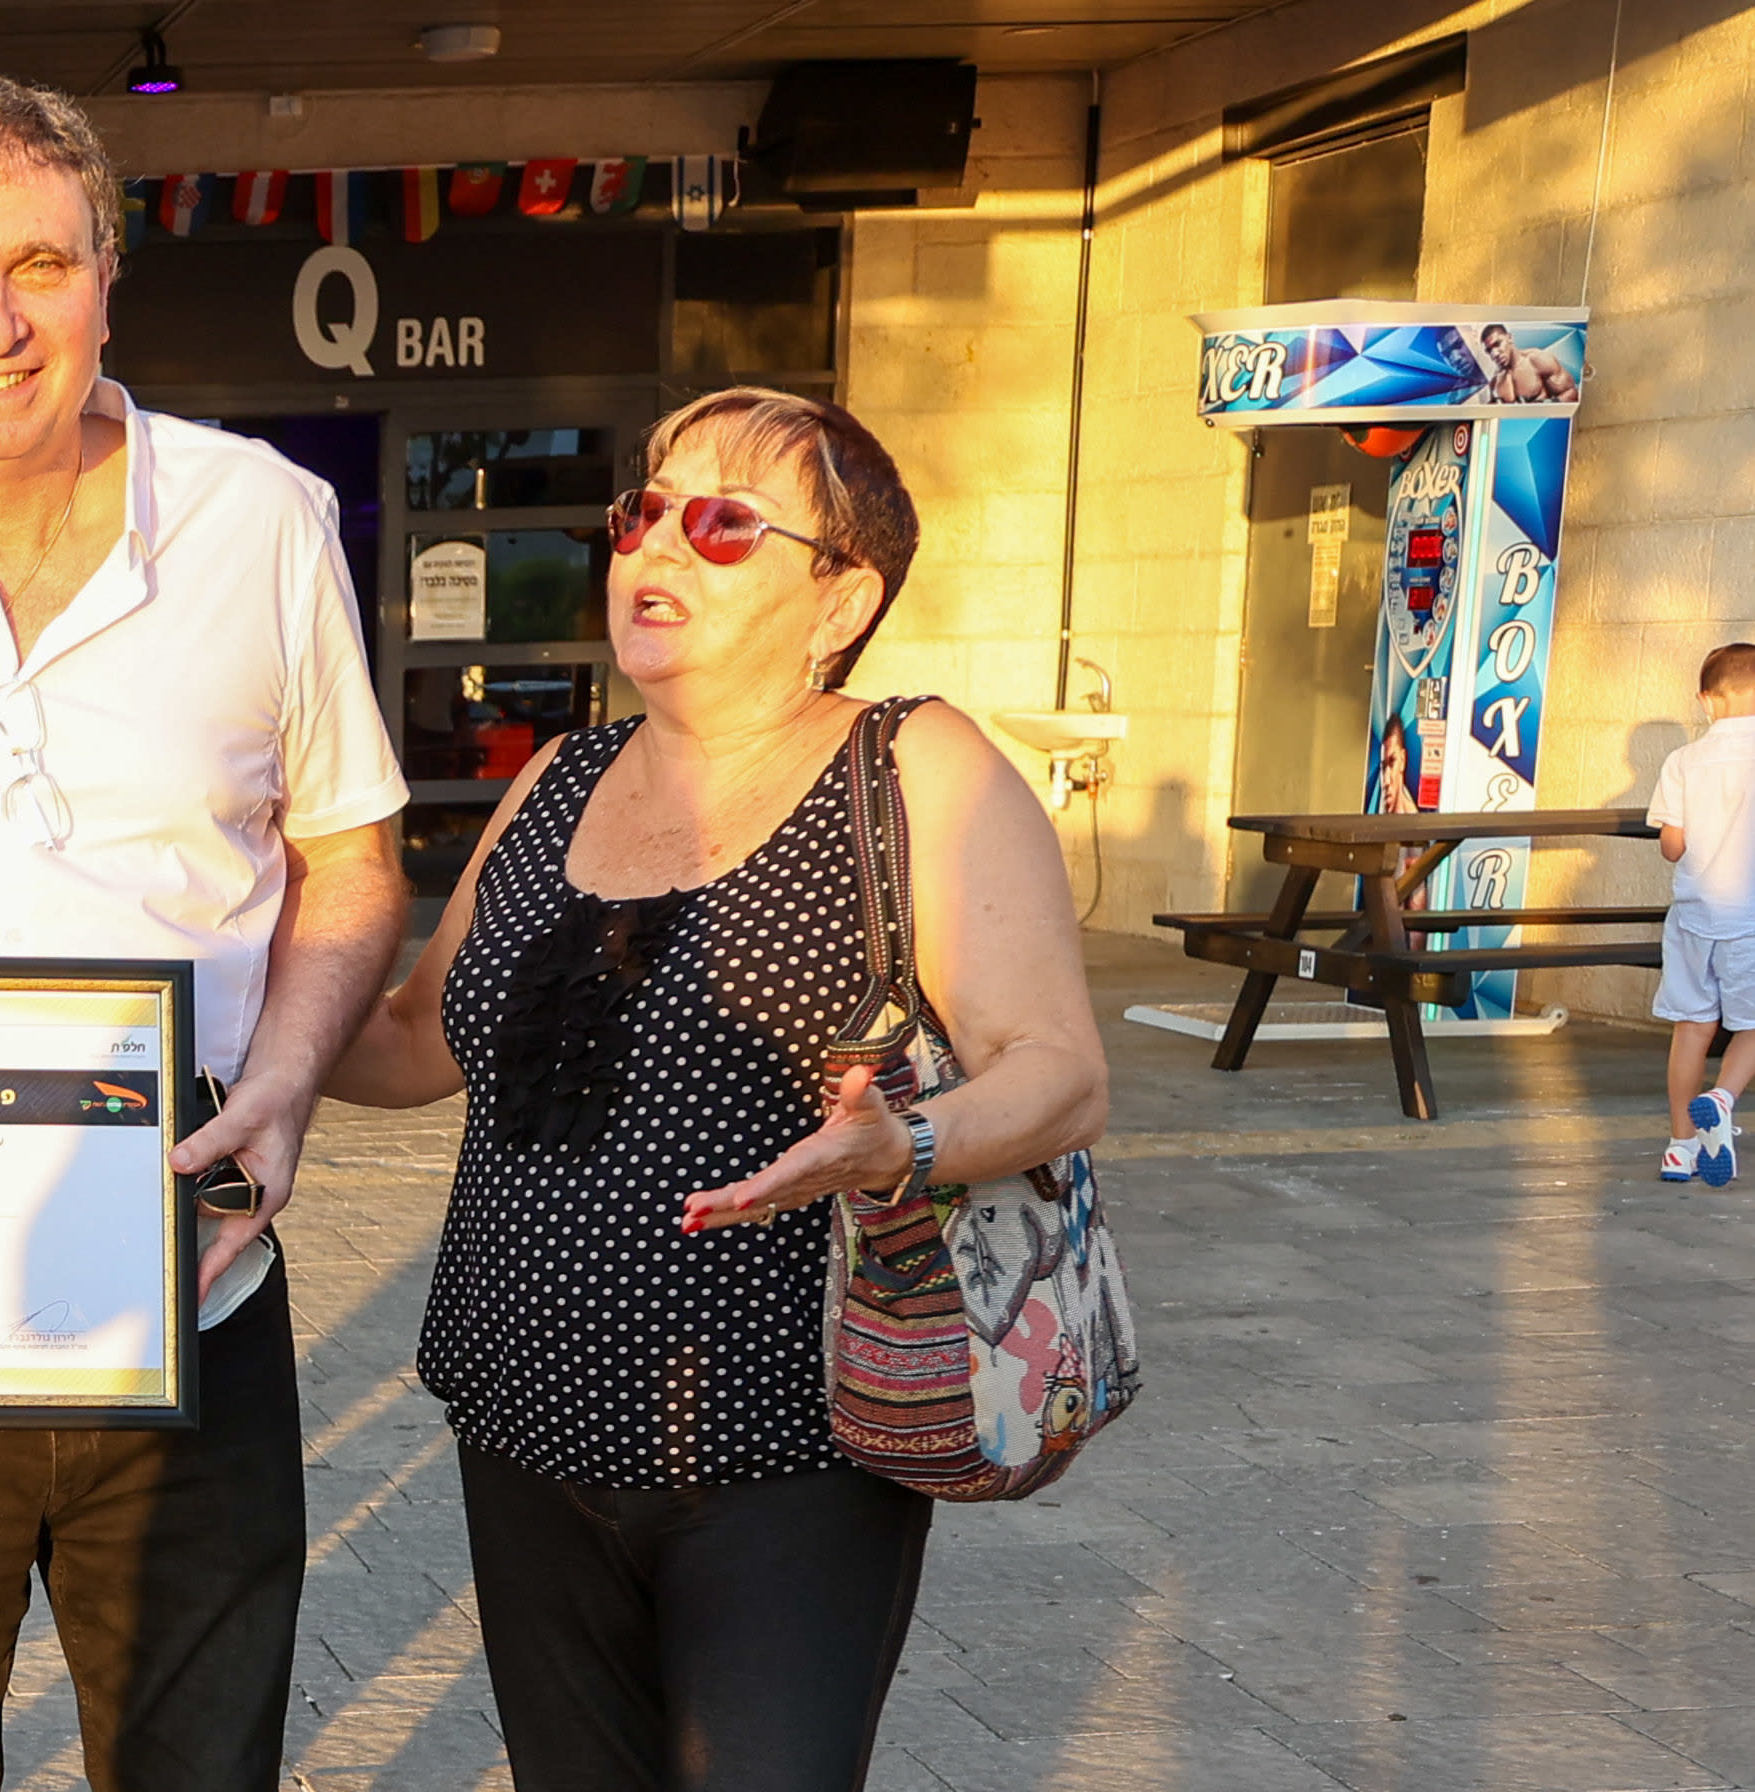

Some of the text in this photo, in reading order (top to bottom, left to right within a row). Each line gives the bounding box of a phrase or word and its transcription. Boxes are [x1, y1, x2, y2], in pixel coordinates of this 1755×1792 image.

[293, 245, 485, 376] Q BAR
[1399, 461, 1461, 499] BOXER
